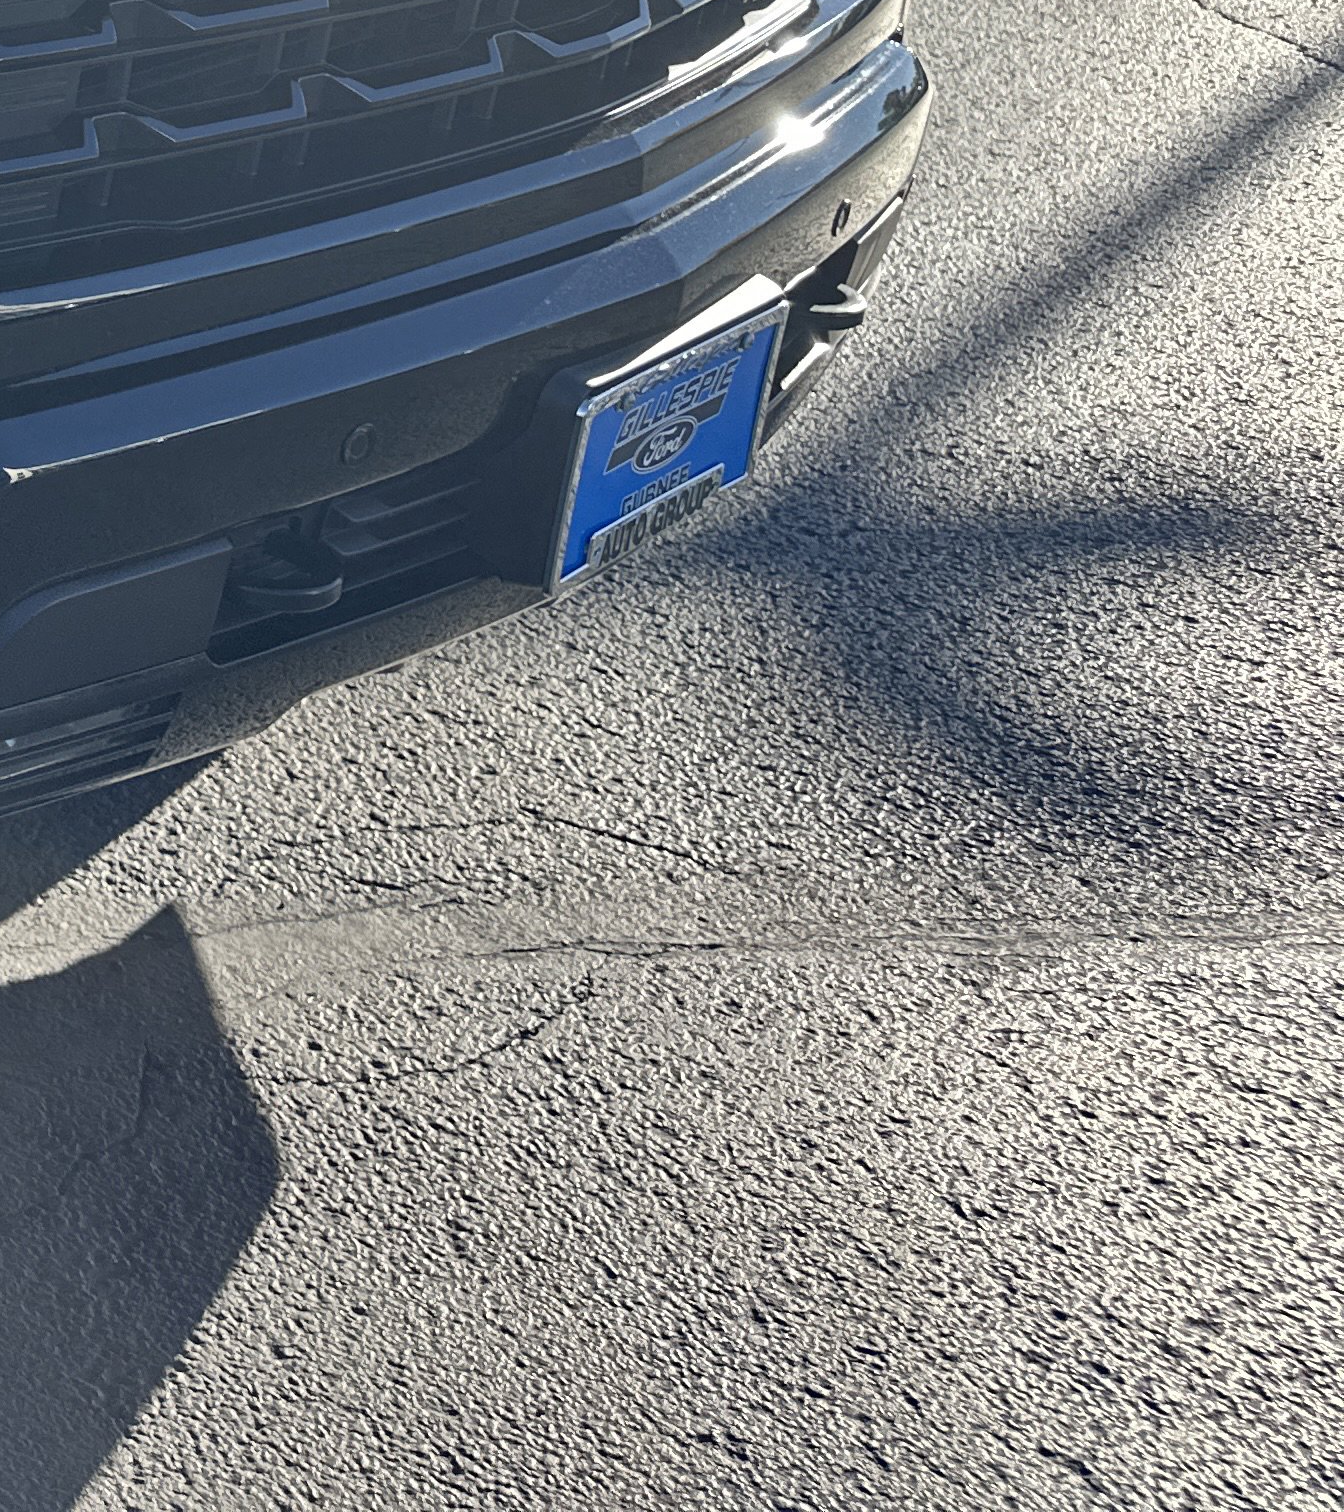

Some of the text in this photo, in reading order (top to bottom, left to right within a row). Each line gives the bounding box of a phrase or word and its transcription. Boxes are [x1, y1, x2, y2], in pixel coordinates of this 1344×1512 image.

[615, 356, 742, 446] GILLESPIE
[642, 428, 685, 467] Ford
[599, 476, 714, 567] AUTO GROUP
